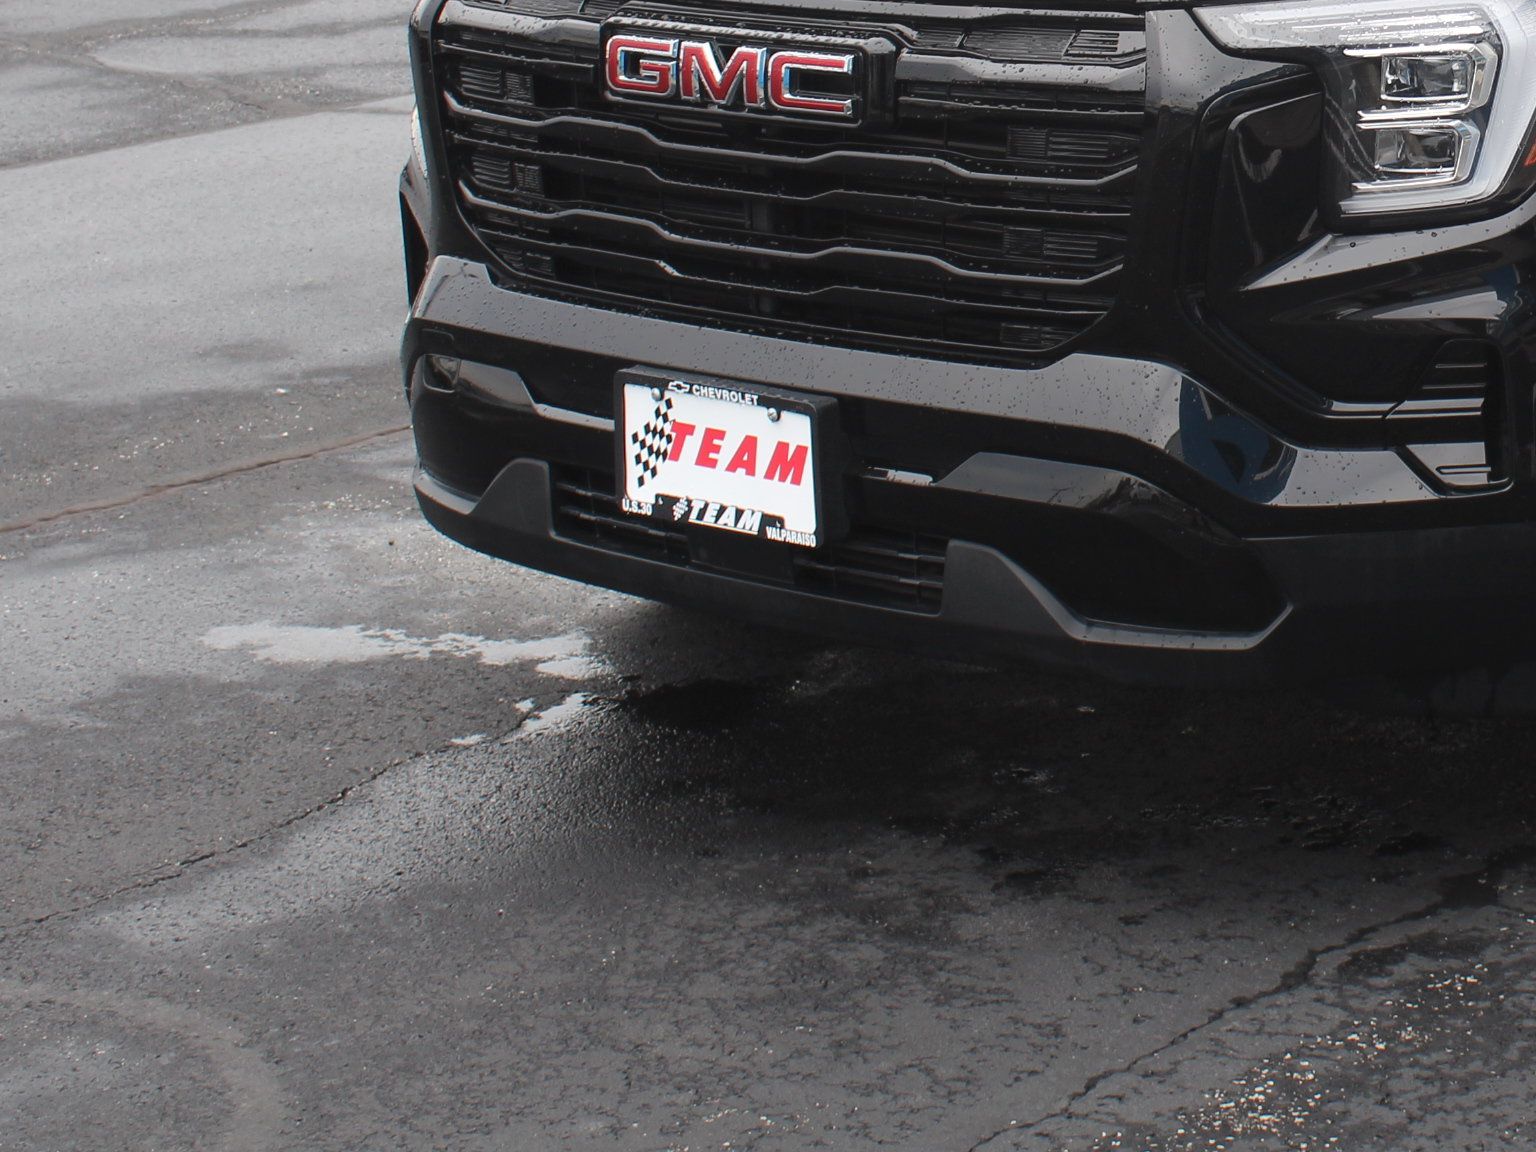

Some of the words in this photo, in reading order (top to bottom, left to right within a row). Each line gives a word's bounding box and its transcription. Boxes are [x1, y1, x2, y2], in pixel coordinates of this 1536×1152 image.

[605, 34, 855, 115] GMC
[691, 383, 759, 407] CHEVROLET
[666, 420, 809, 487] TEAM
[689, 499, 763, 535] TEAM
[765, 525, 817, 548] VALPARAISO
